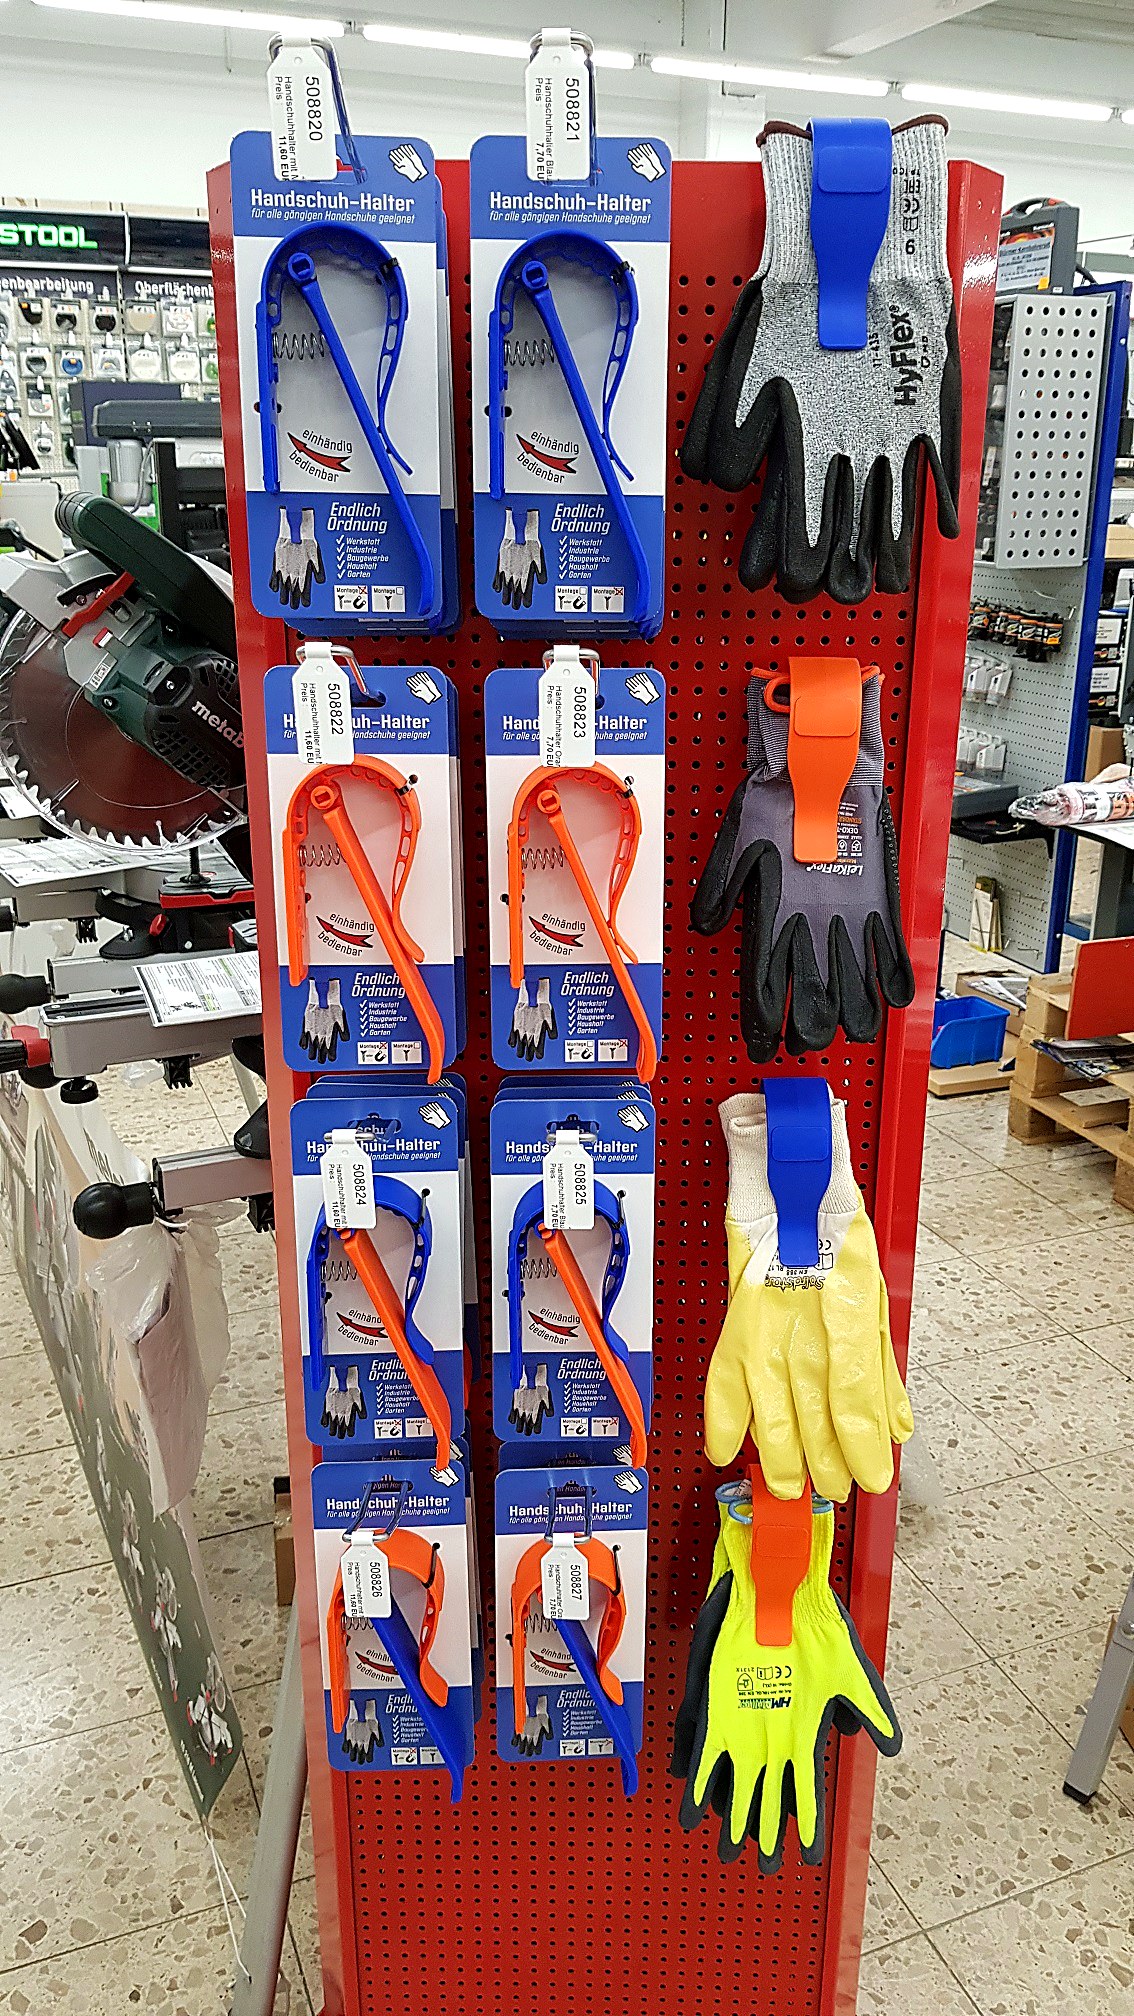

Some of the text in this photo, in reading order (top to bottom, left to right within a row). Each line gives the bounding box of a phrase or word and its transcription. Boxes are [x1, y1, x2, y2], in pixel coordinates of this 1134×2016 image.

[306, 76, 323, 141] 508820
[544, 77, 553, 158] Handschuhhalter
[566, 77, 580, 140] 508821
[284, 76, 298, 173] Handschuhhalter mit
[279, 136, 287, 160] 11,60
[536, 142, 544, 163] 7,70
[251, 188, 415, 212] Handschuh-Halter
[490, 191, 651, 211] Handschuh-Halter
[251, 208, 415, 224] für alle gängigen Handschuhe geeignet
[490, 211, 651, 224] für alle gängigen Handschuhe geeignet
[303, 428, 353, 453] einhändig
[531, 431, 579, 455] einhändig
[289, 450, 339, 483] bedienbar
[517, 452, 565, 484] bedienbar
[330, 502, 381, 517] Endlich
[555, 503, 604, 519] Endlich
[327, 517, 387, 534] Ordnung
[551, 518, 610, 535] Ordnung
[569, 538, 602, 546] Werkstatt
[346, 554, 389, 562] Baugewerbe
[569, 555, 610, 563] Baugewerbe
[569, 563, 598, 571] Haushalt
[309, 683, 320, 746] Handschuhhalter
[328, 683, 344, 735] 508822
[555, 686, 563, 748] Handschuhhalter
[574, 686, 587, 738] 508823
[284, 730, 296, 739] für
[305, 730, 313, 749] 11,60
[397, 731, 430, 740] geeignet
[503, 731, 515, 740] für
[516, 732, 530, 740] alle
[615, 731, 647, 741] geeignet
[546, 736, 554, 753] 7,70
[329, 912, 375, 933] einhändig
[542, 912, 586, 932] einhändig
[318, 931, 363, 957] bedienbar
[529, 930, 573, 956] bedienbar
[355, 972, 400, 985] Endlich
[564, 972, 609, 984] Endlich
[351, 985, 406, 998] Ordnung
[560, 984, 614, 997] Ordnung
[411, 1152, 441, 1161] geeignet
[608, 1154, 638, 1163] geeignet
[353, 1164, 367, 1206] 508824
[574, 1163, 587, 1205] 508825
[540, 1308, 580, 1324] einhändig
[338, 1325, 379, 1346] bedienbar
[529, 1323, 569, 1345] bedienbar
[560, 1358, 601, 1369] Endlich
[557, 1369, 607, 1380] Ordnung
[370, 1562, 382, 1597] 508826
[571, 1564, 582, 1600] 508827
[357, 1663, 395, 1683] bedienbar
[530, 1661, 567, 1679] bedienbar
[771, 1697, 791, 1709] HM
